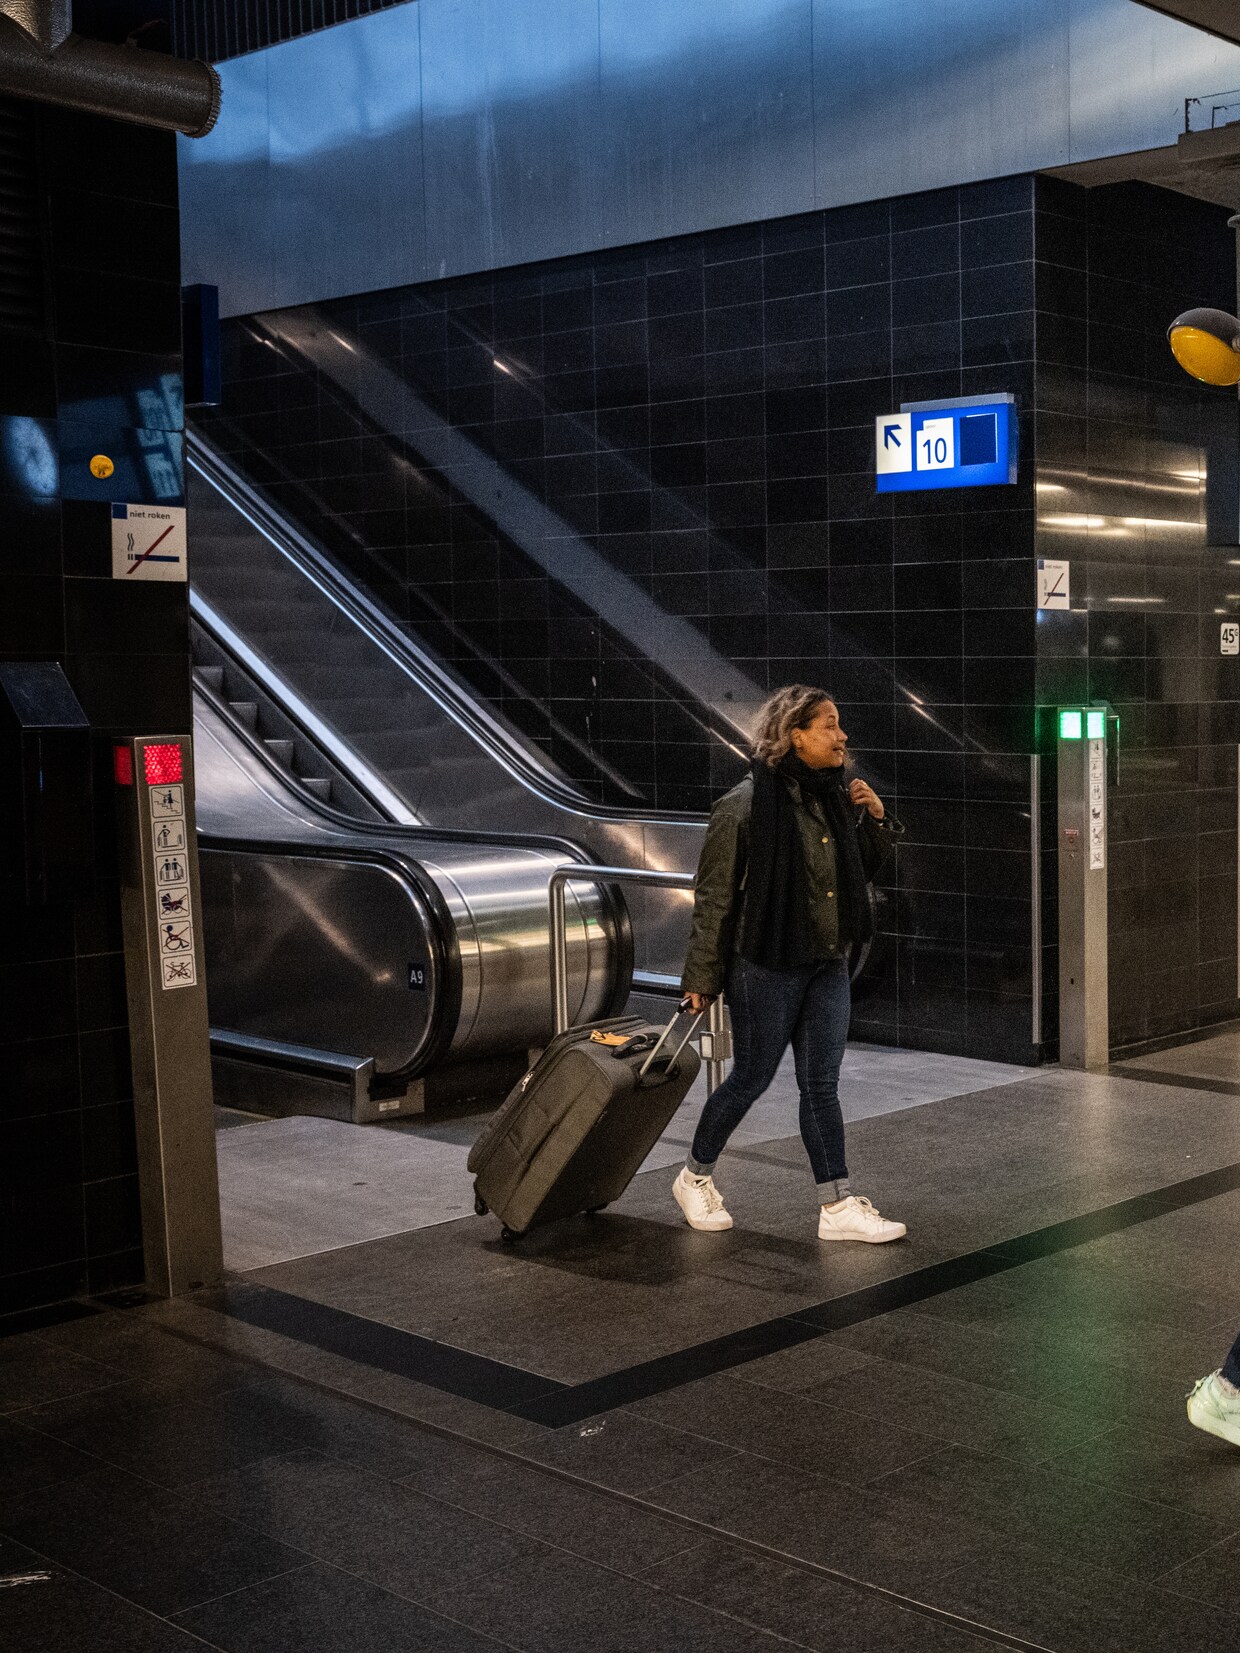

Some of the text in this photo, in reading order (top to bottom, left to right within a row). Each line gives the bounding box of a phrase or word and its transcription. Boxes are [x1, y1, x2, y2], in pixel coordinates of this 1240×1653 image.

[922, 437, 947, 464] 10
[129, 510, 171, 520] niet roken
[409, 969, 424, 984] A9
